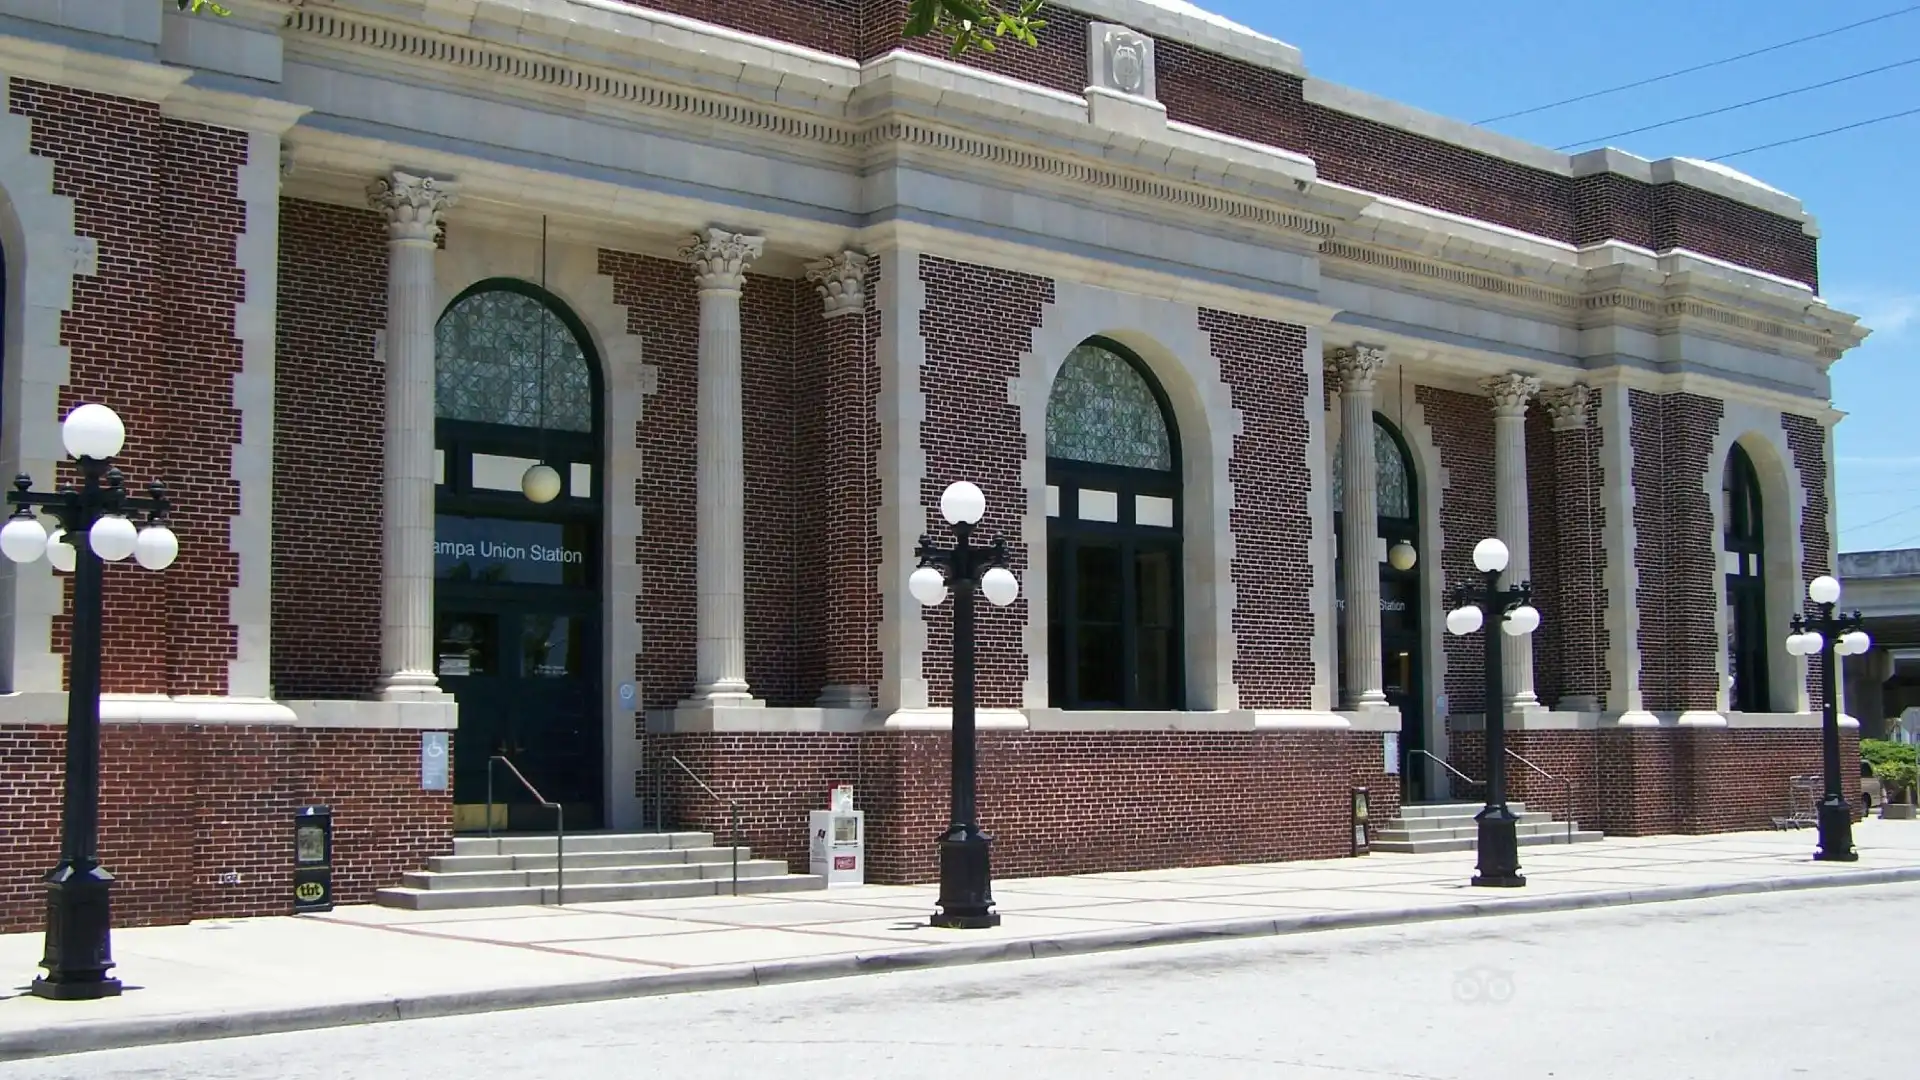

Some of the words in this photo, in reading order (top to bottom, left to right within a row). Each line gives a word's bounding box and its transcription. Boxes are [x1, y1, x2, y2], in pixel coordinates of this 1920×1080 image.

[433, 541, 475, 559] ampa
[480, 540, 525, 560] Union
[530, 544, 582, 564] Station
[1380, 598, 1406, 611] Station
[300, 883, 321, 897] tbt
